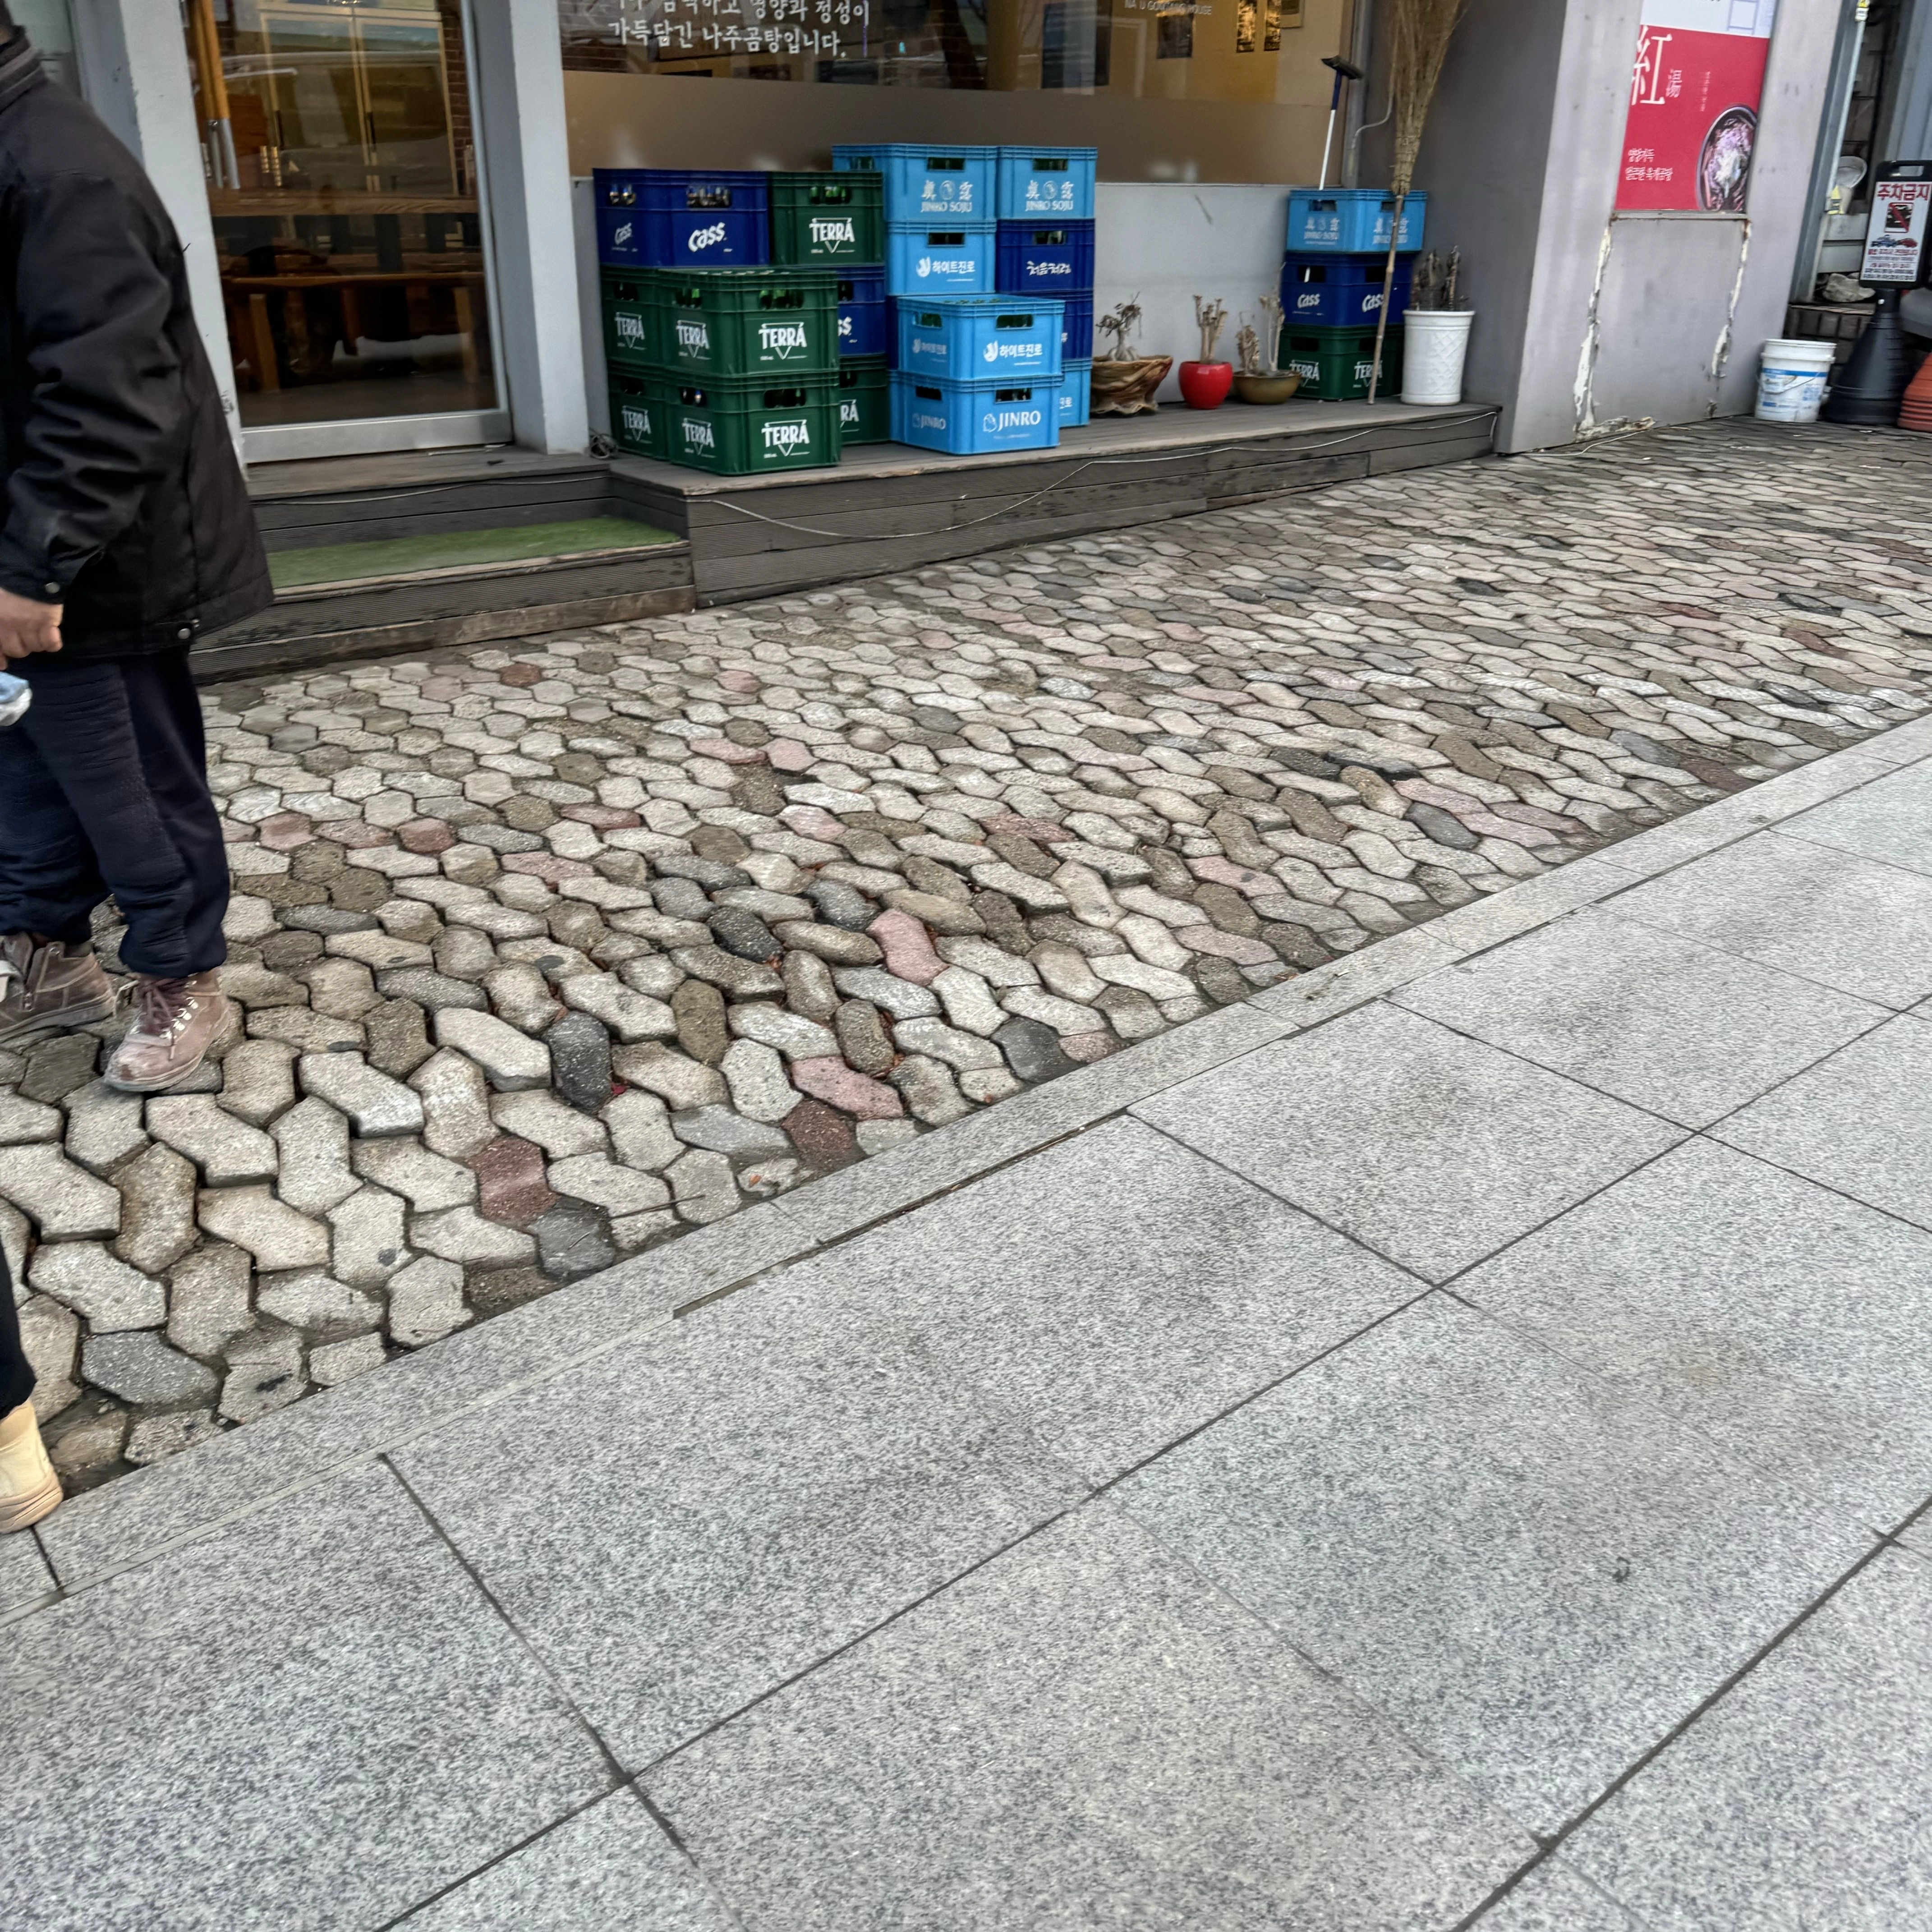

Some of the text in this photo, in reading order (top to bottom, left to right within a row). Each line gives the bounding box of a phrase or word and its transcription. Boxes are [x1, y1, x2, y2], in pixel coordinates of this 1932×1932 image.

[816, 0, 869, 26] 정성이
[608, 17, 846, 58] 가득담긴 나주곰탕입니다.
[1877, 184, 1930, 201] 주차금지
[809, 221, 855, 242] TERRA
[932, 261, 975, 274] 하이트진로
[615, 316, 645, 340] TERRA
[676, 324, 710, 350] TERRA
[758, 327, 807, 348] TERRA
[999, 344, 1043, 358] 하이트진로
[622, 409, 651, 434] TERRA
[998, 410, 1041, 432] JINRO
[682, 422, 715, 449] TERRA
[761, 425, 810, 444] TERRA
